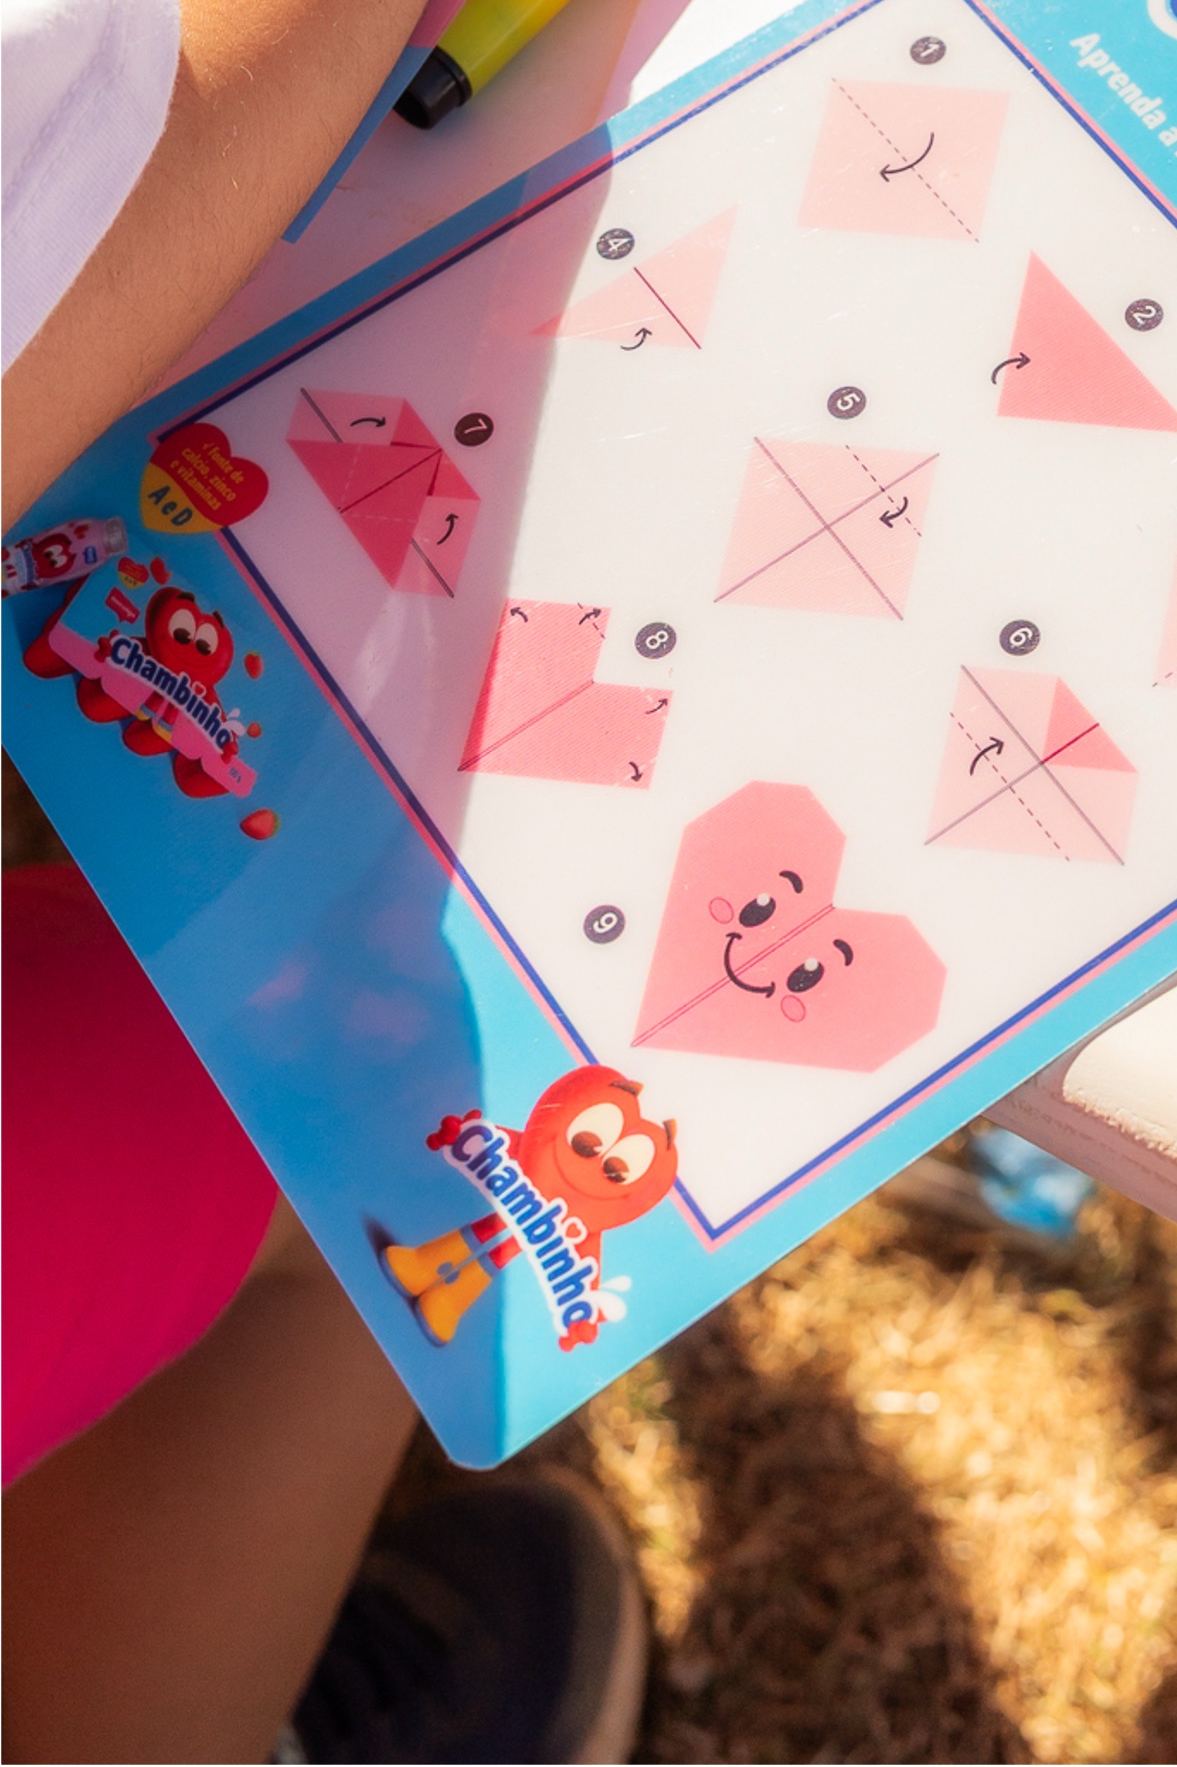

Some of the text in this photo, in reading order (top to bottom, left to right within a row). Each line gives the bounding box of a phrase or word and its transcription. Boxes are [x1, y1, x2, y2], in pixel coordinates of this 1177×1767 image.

[920, 44, 940, 58] 1
[1069, 33, 1167, 129] Aprenda
[608, 238, 631, 252] 4
[1133, 306, 1156, 324] 2
[836, 393, 860, 410] 5
[464, 419, 487, 434] 7
[177, 464, 222, 510] vitaminas
[209, 476, 237, 502] zinco
[147, 486, 193, 526] A e D
[646, 631, 668, 649] 8
[1010, 628, 1032, 647] 6
[111, 637, 232, 749] Chambinho
[593, 913, 617, 933] 9
[451, 1125, 593, 1328] Chambinho
